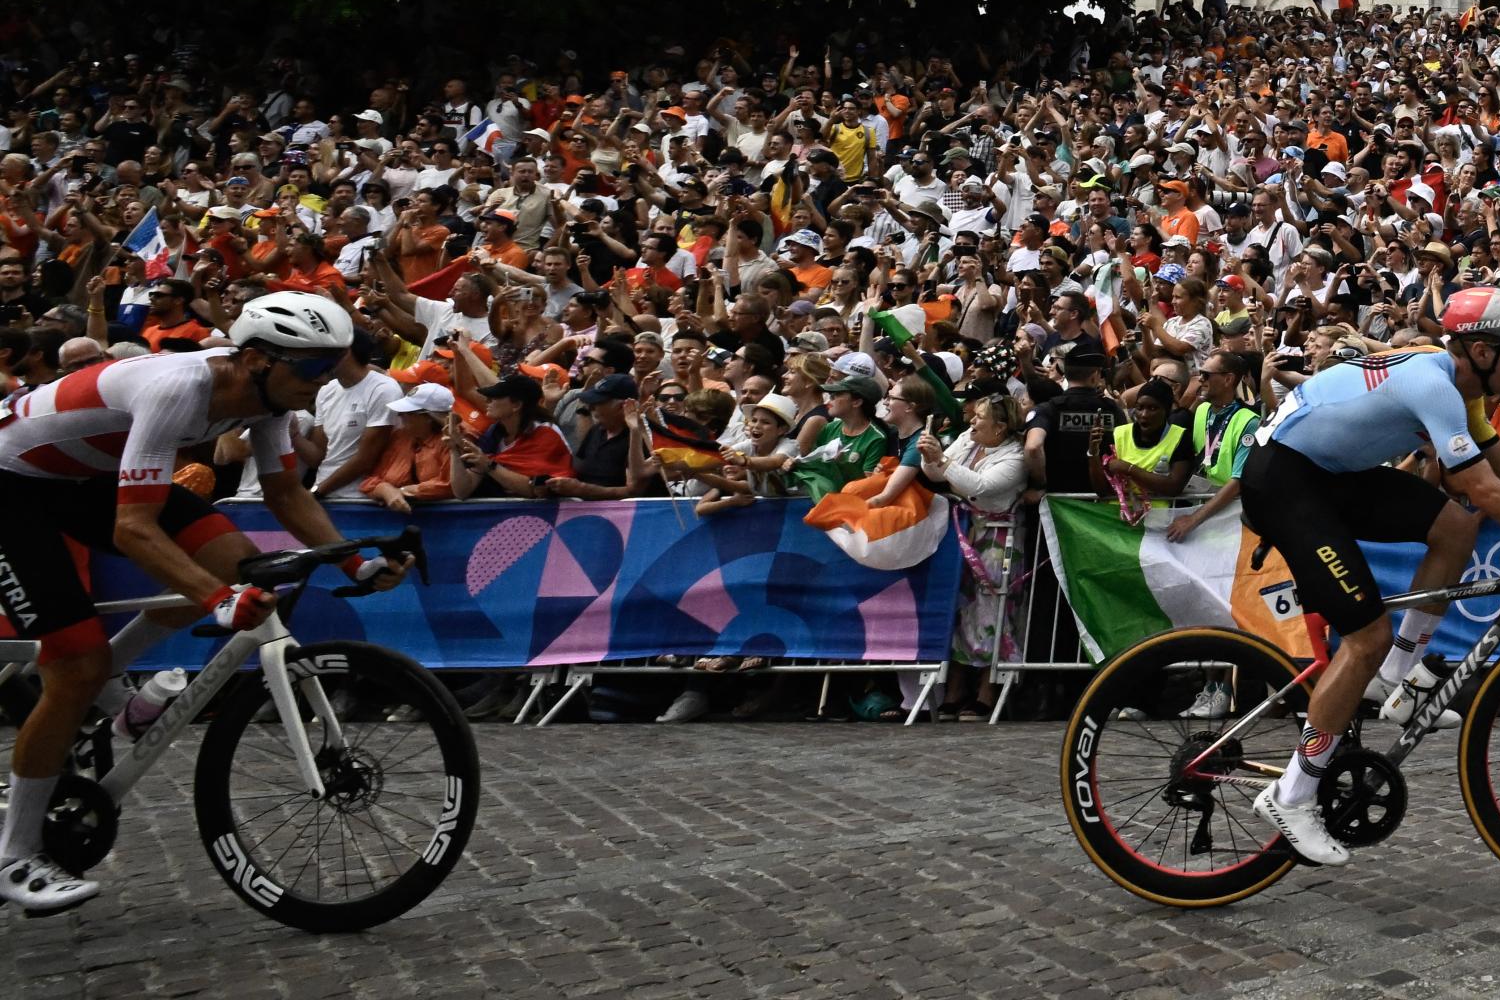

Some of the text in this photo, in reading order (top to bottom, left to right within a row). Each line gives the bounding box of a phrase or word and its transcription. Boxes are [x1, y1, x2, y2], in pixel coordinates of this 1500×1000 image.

[303, 308, 325, 333] MET
[1063, 414, 1112, 427] POLIE
[119, 468, 163, 482] AUT
[1316, 545, 1360, 594] BEL
[1275, 594, 1291, 615] 6
[132, 649, 236, 762] COLNAGO
[1400, 629, 1500, 750] S-WORKS
[212, 832, 285, 908] ENVE
